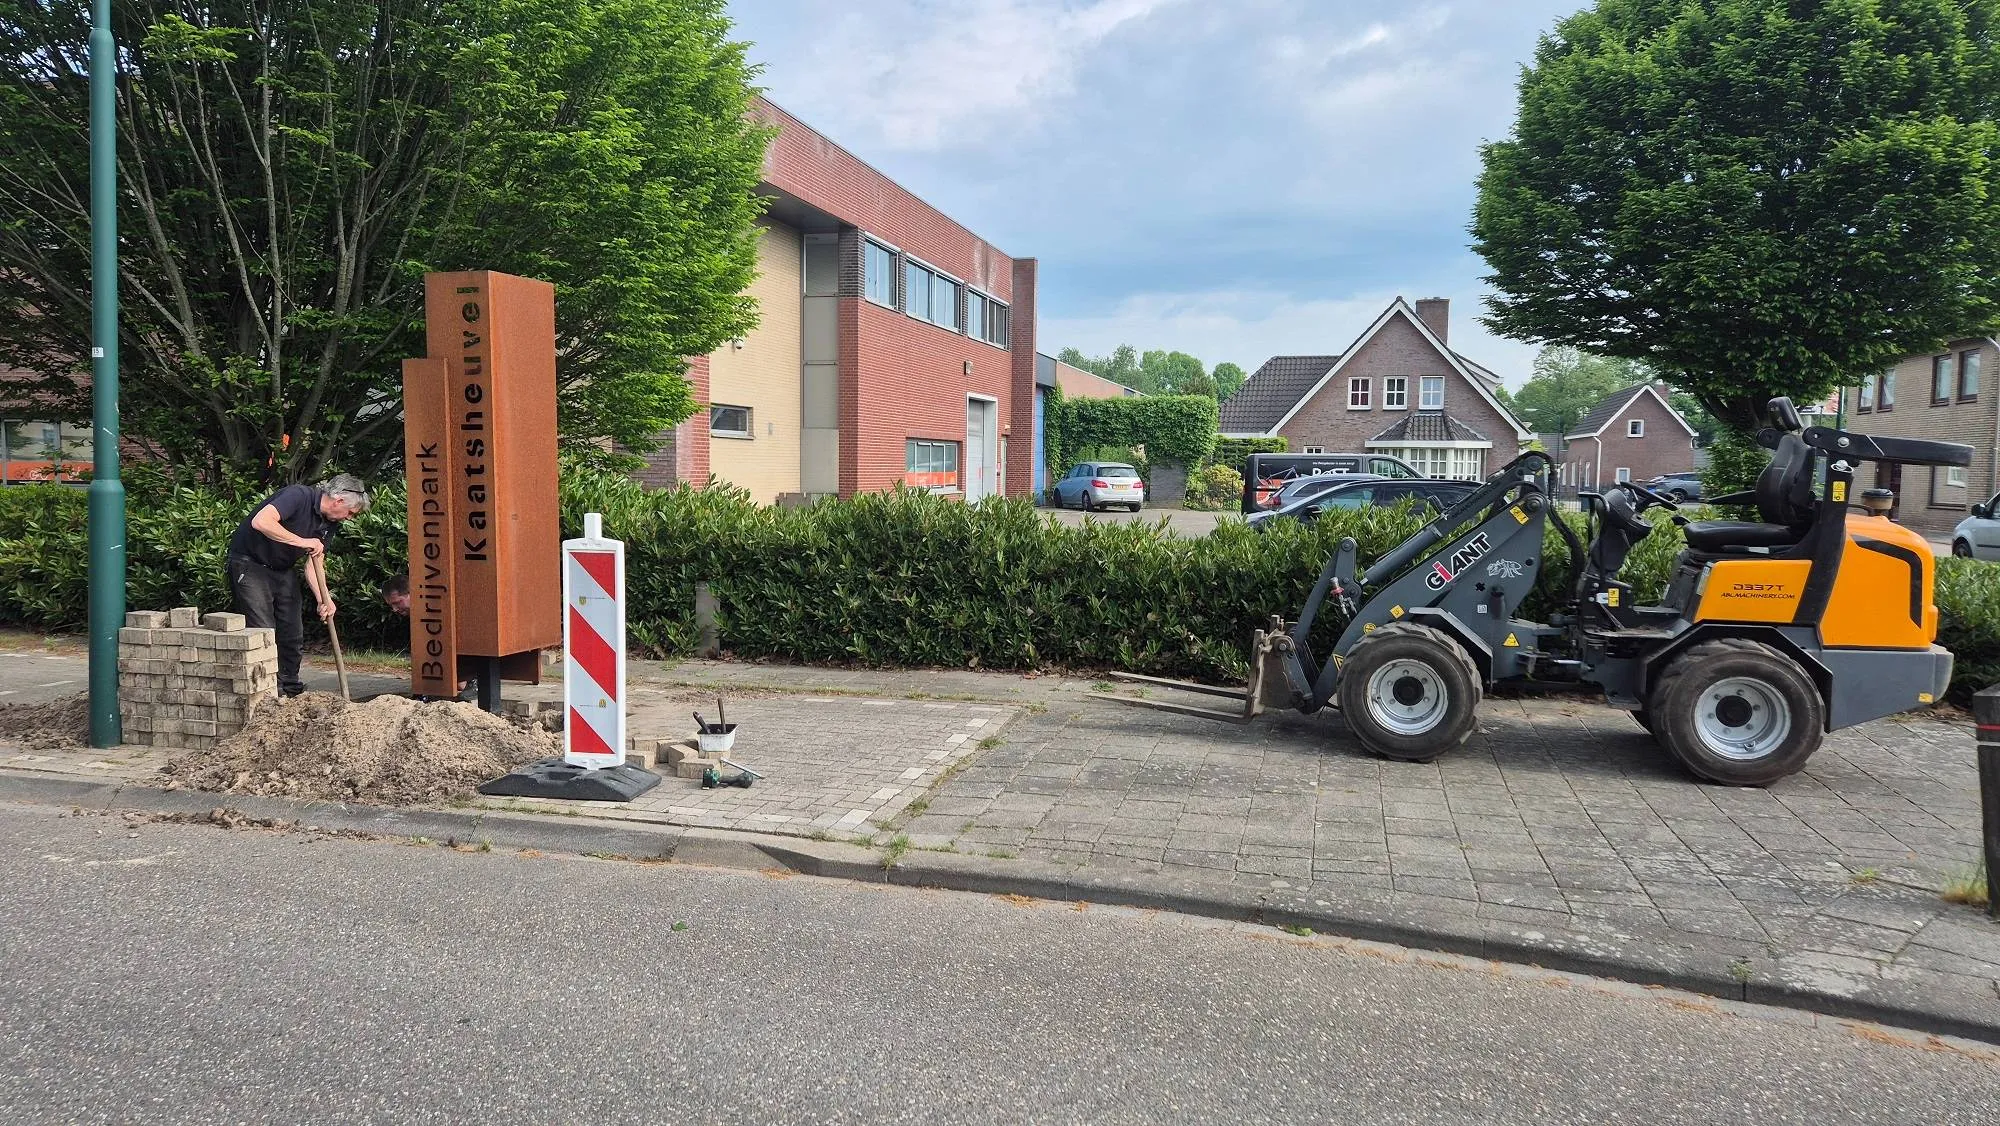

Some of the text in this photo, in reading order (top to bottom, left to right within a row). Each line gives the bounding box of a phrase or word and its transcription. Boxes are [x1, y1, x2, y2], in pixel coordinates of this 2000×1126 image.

[456, 286, 487, 561] Kaatsheuvel
[416, 442, 447, 681] Bedrijvenpark
[1733, 583, 1785, 591] D337T
